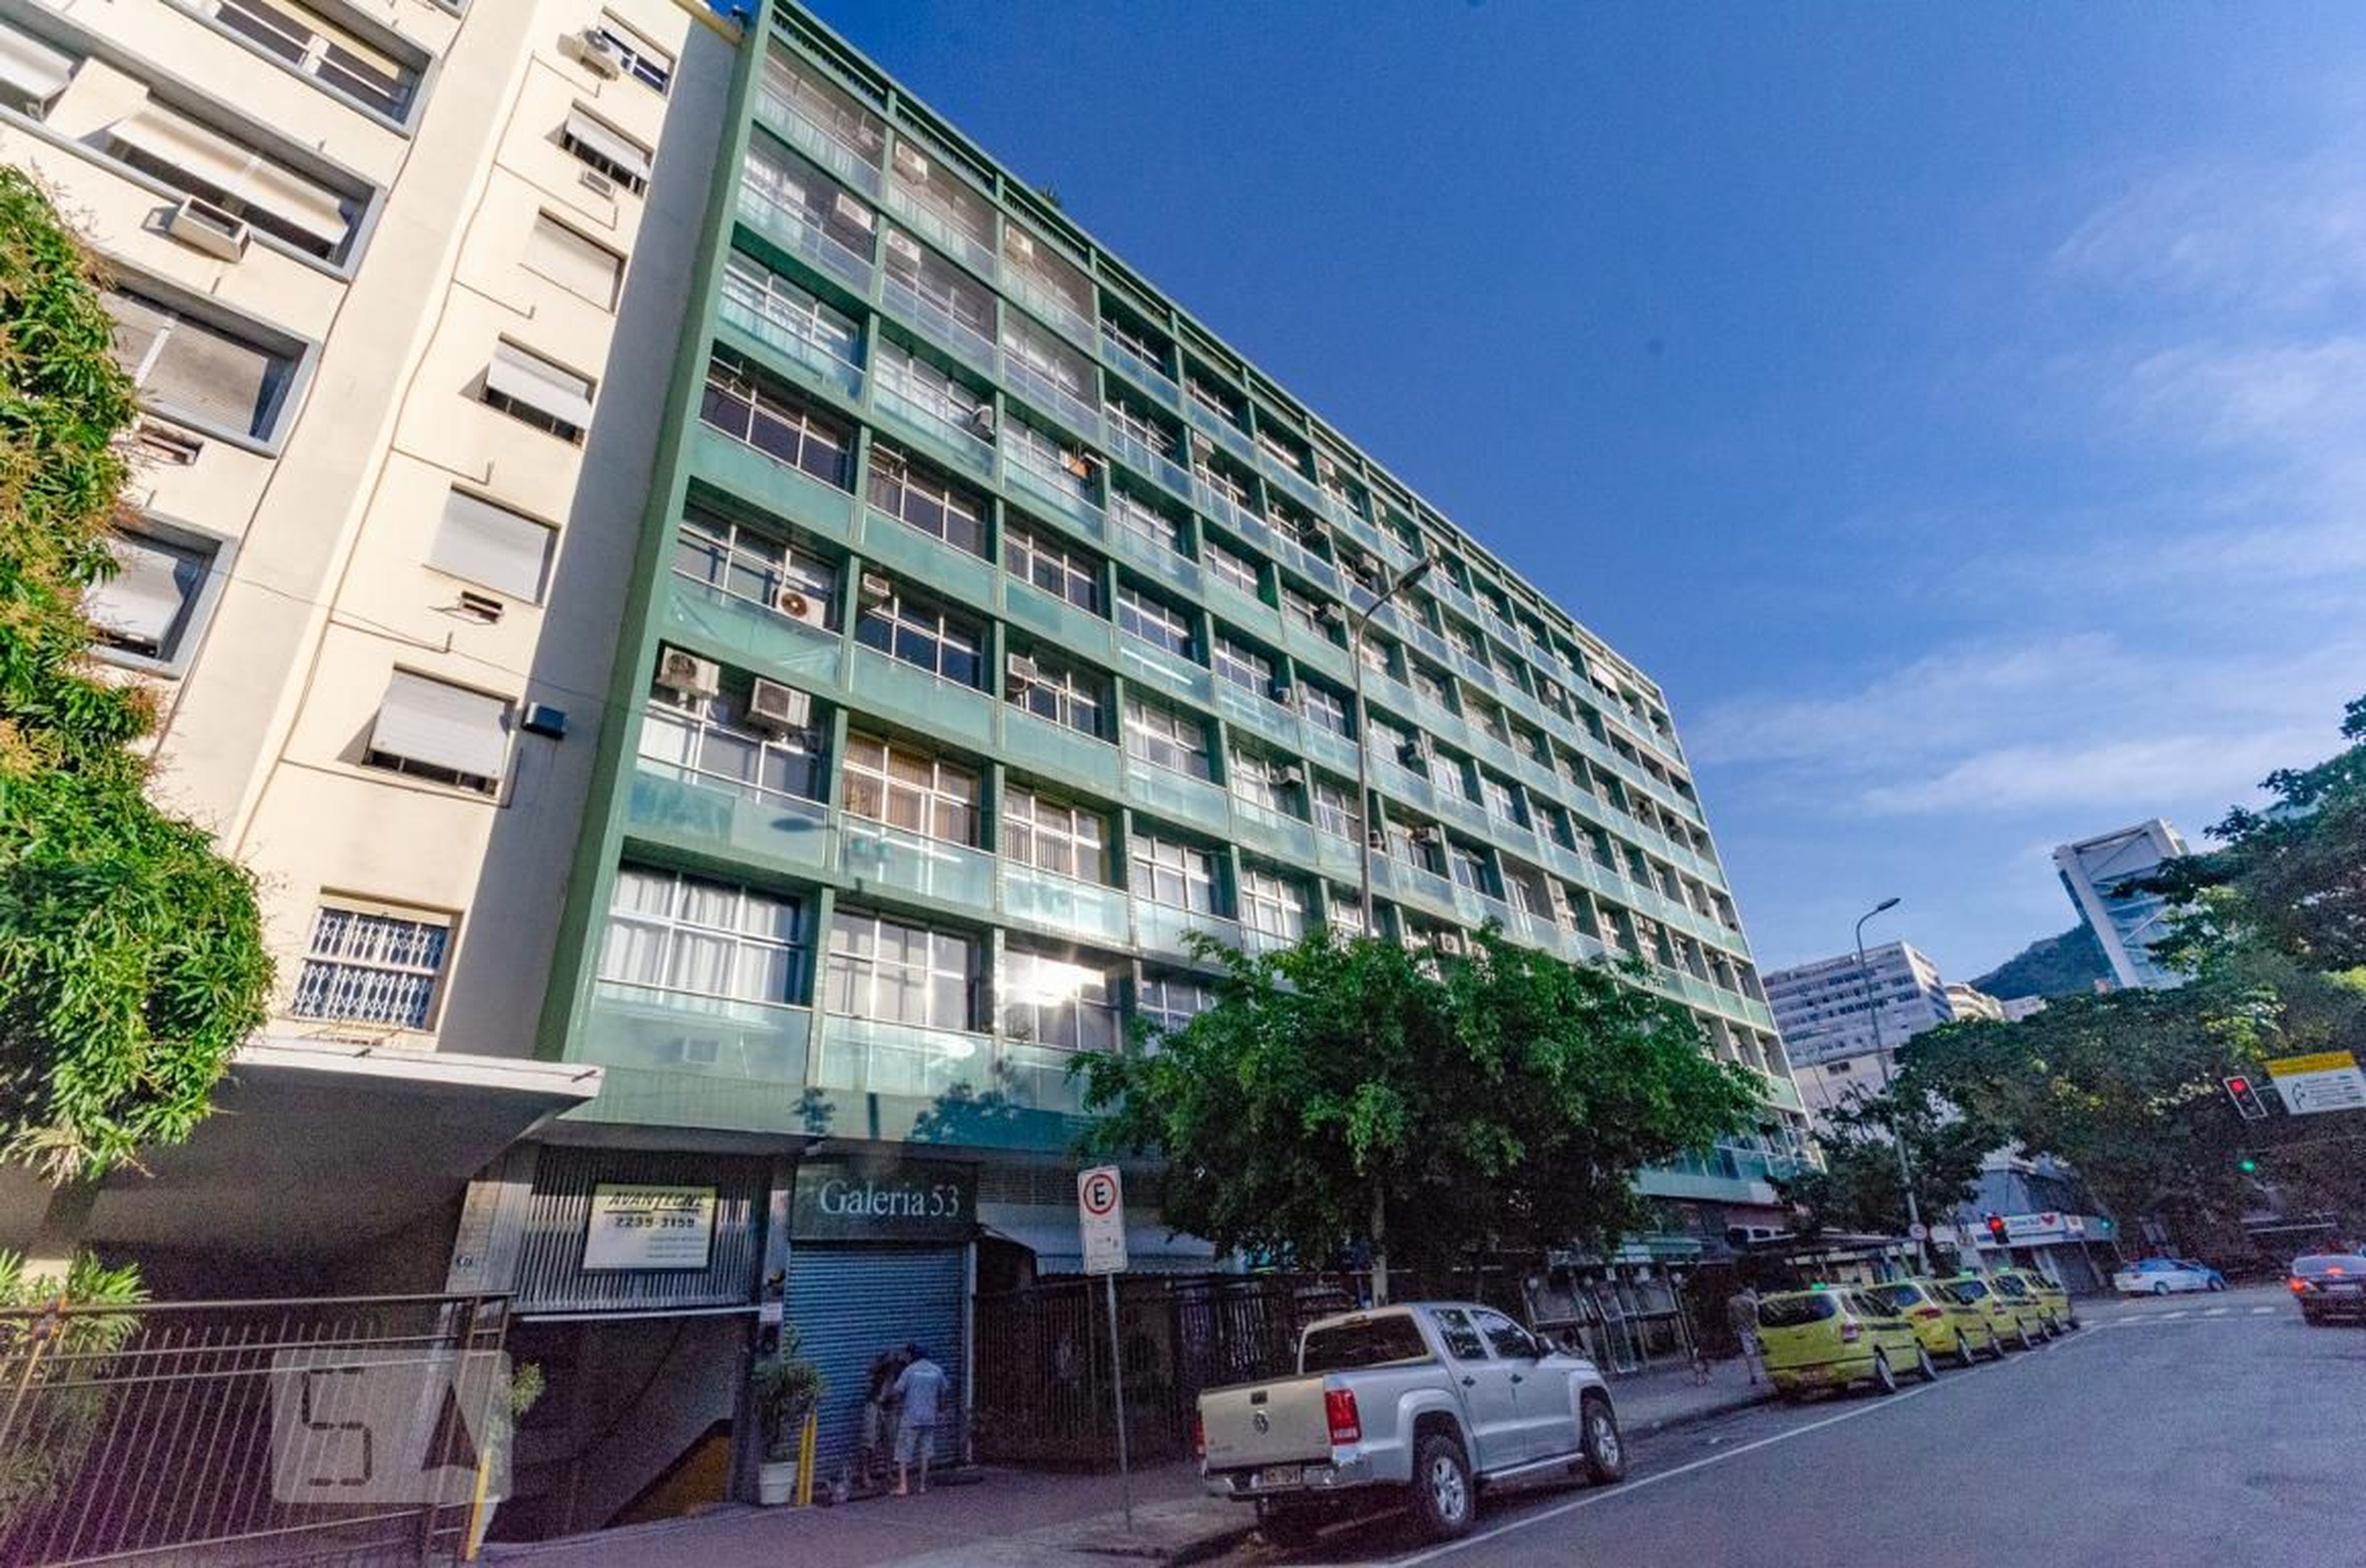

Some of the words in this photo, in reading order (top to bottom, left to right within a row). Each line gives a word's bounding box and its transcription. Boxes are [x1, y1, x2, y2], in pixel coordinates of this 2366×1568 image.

[819, 1179, 925, 1215] Galeria
[930, 1184, 959, 1217] 53
[1094, 1183, 1106, 1206] E
